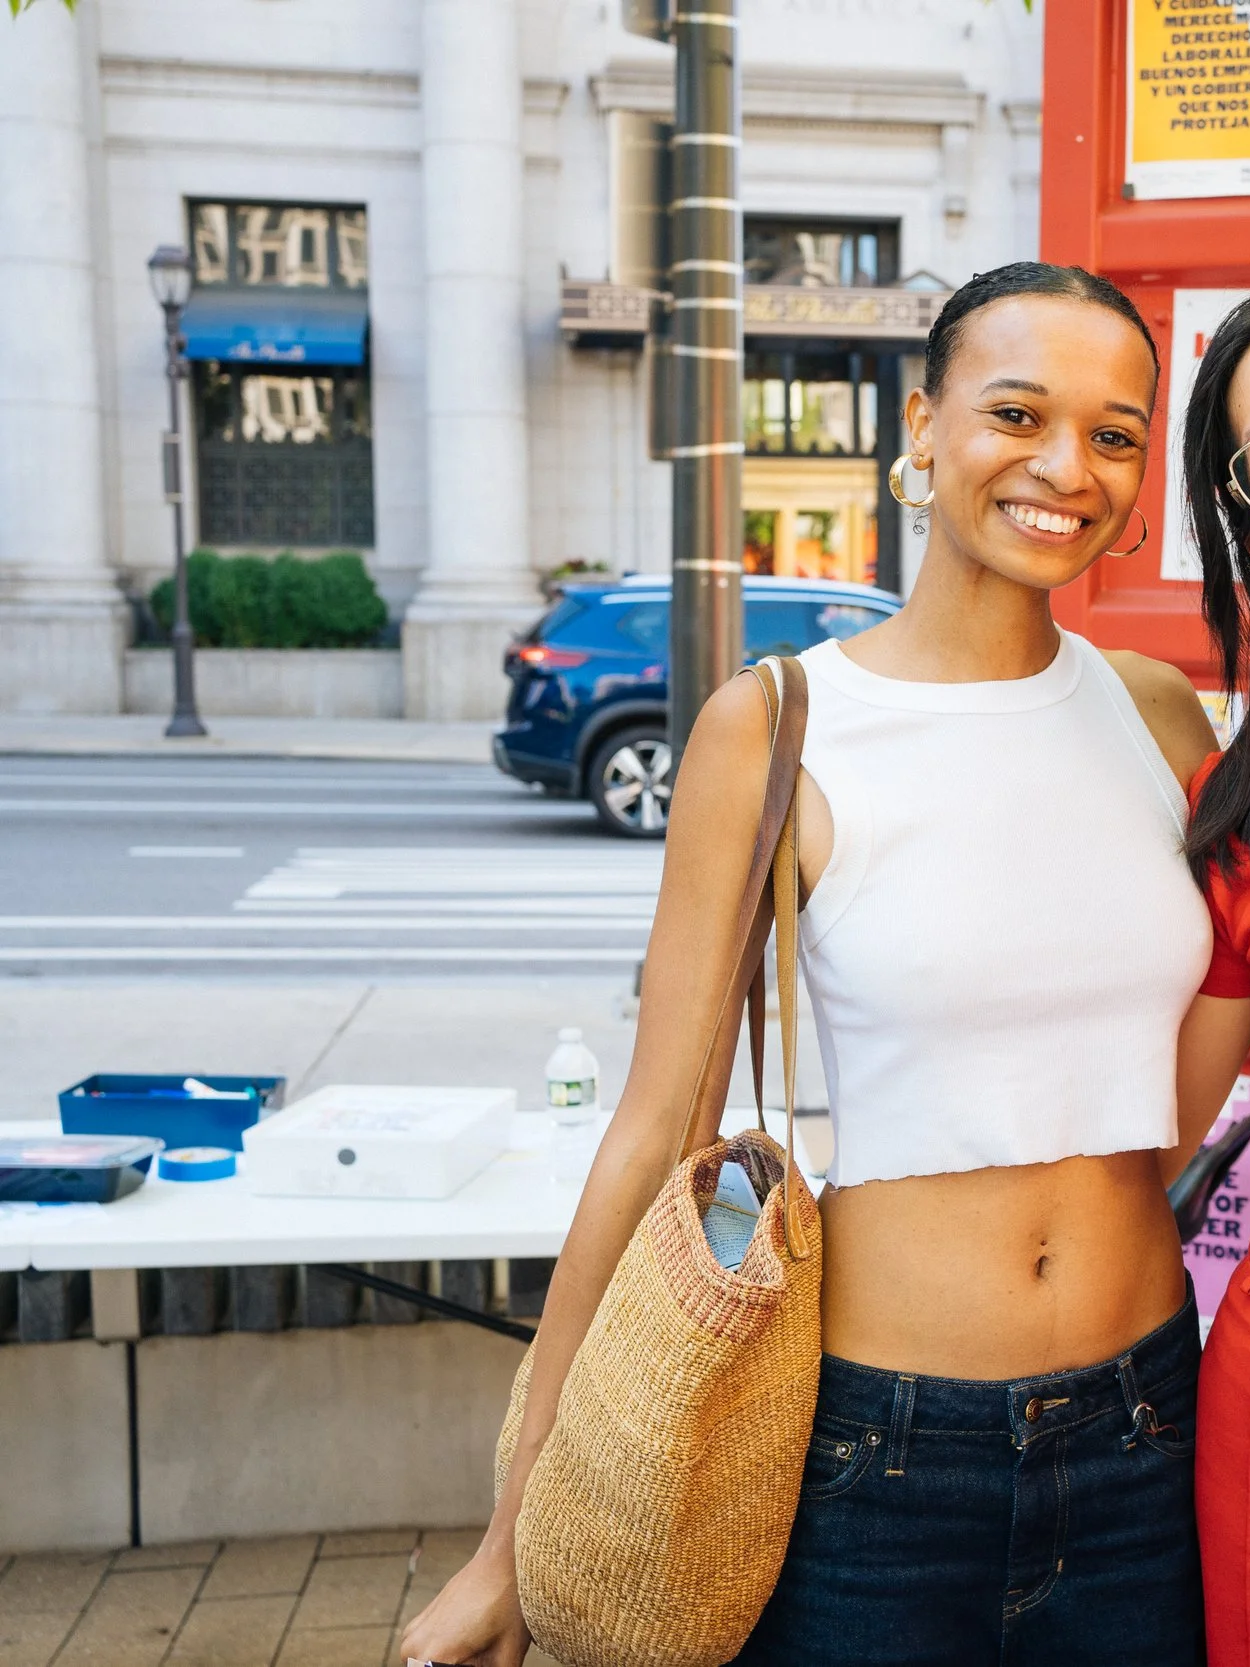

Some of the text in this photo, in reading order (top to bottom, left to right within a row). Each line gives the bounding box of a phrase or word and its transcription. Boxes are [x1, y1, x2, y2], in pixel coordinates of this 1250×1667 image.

[1140, 66, 1207, 81] BUENOS
[1152, 86, 1161, 97] Y
[1165, 84, 1187, 96] UN
[1179, 99, 1249, 115] QUE NOS
[1216, 1195, 1249, 1214] OF
[1183, 1243, 1248, 1261] TION
